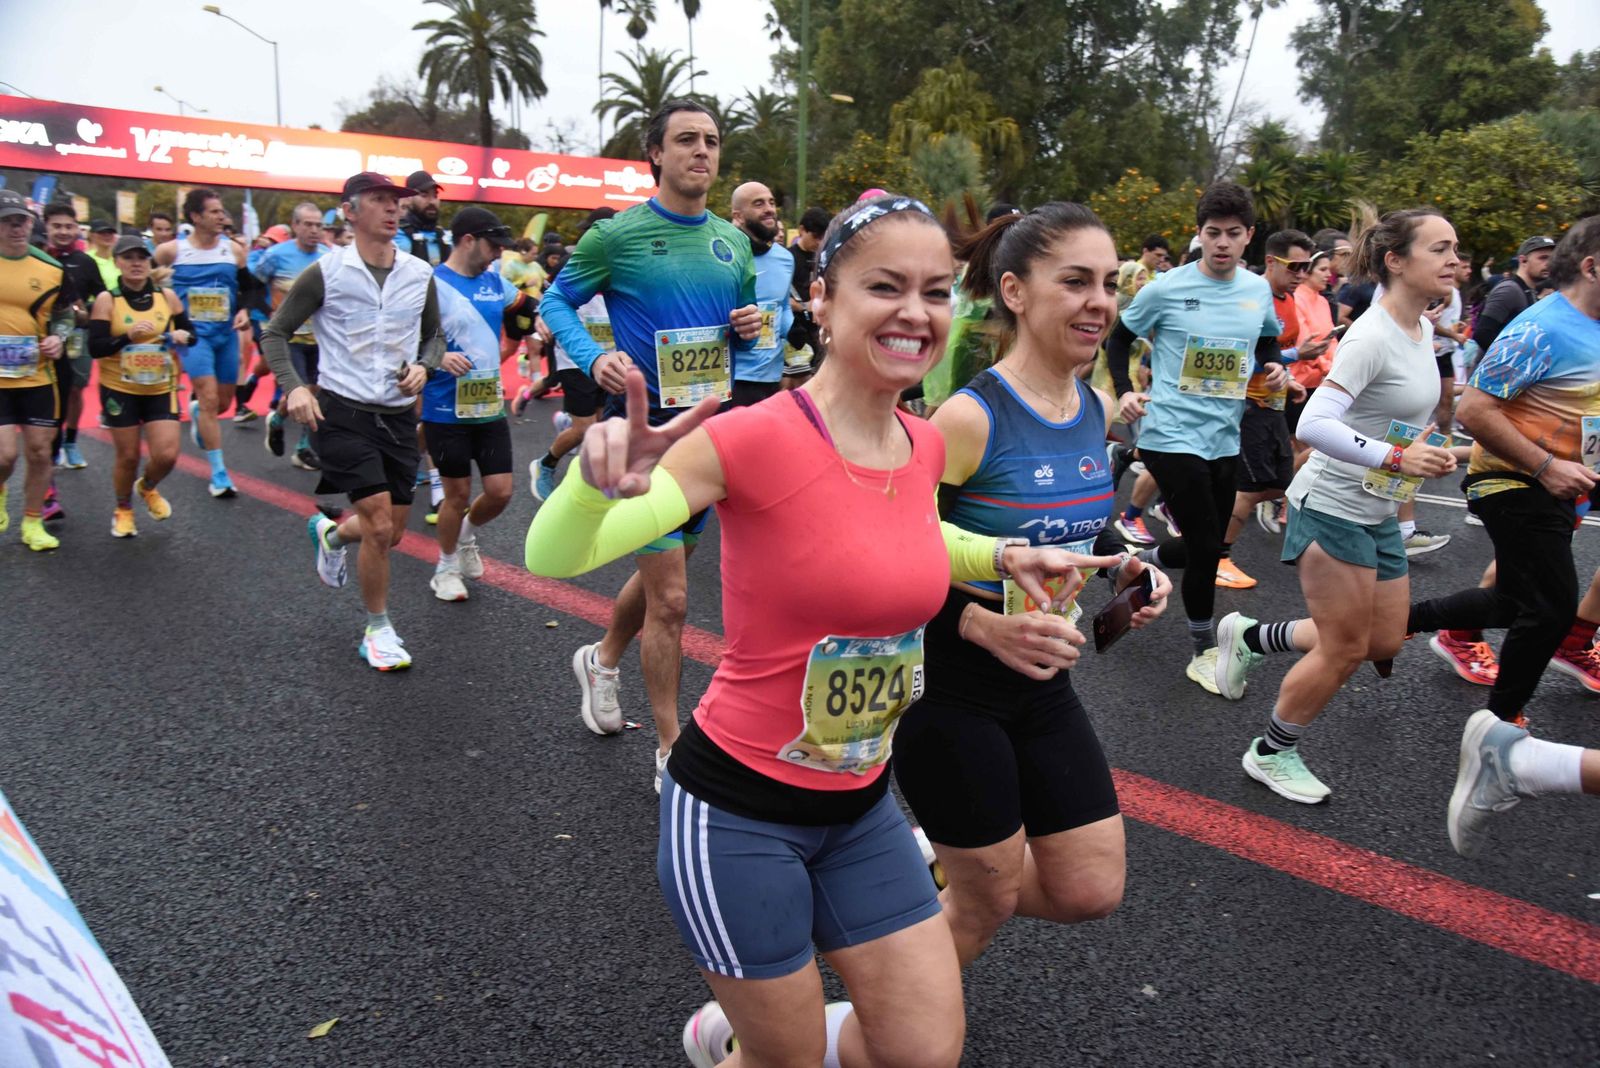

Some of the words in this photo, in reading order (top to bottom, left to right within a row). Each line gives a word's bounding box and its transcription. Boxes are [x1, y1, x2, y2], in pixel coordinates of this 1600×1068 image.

[672, 347, 721, 373] 8222
[1194, 351, 1236, 371] 8336
[826, 665, 905, 717] 8524
